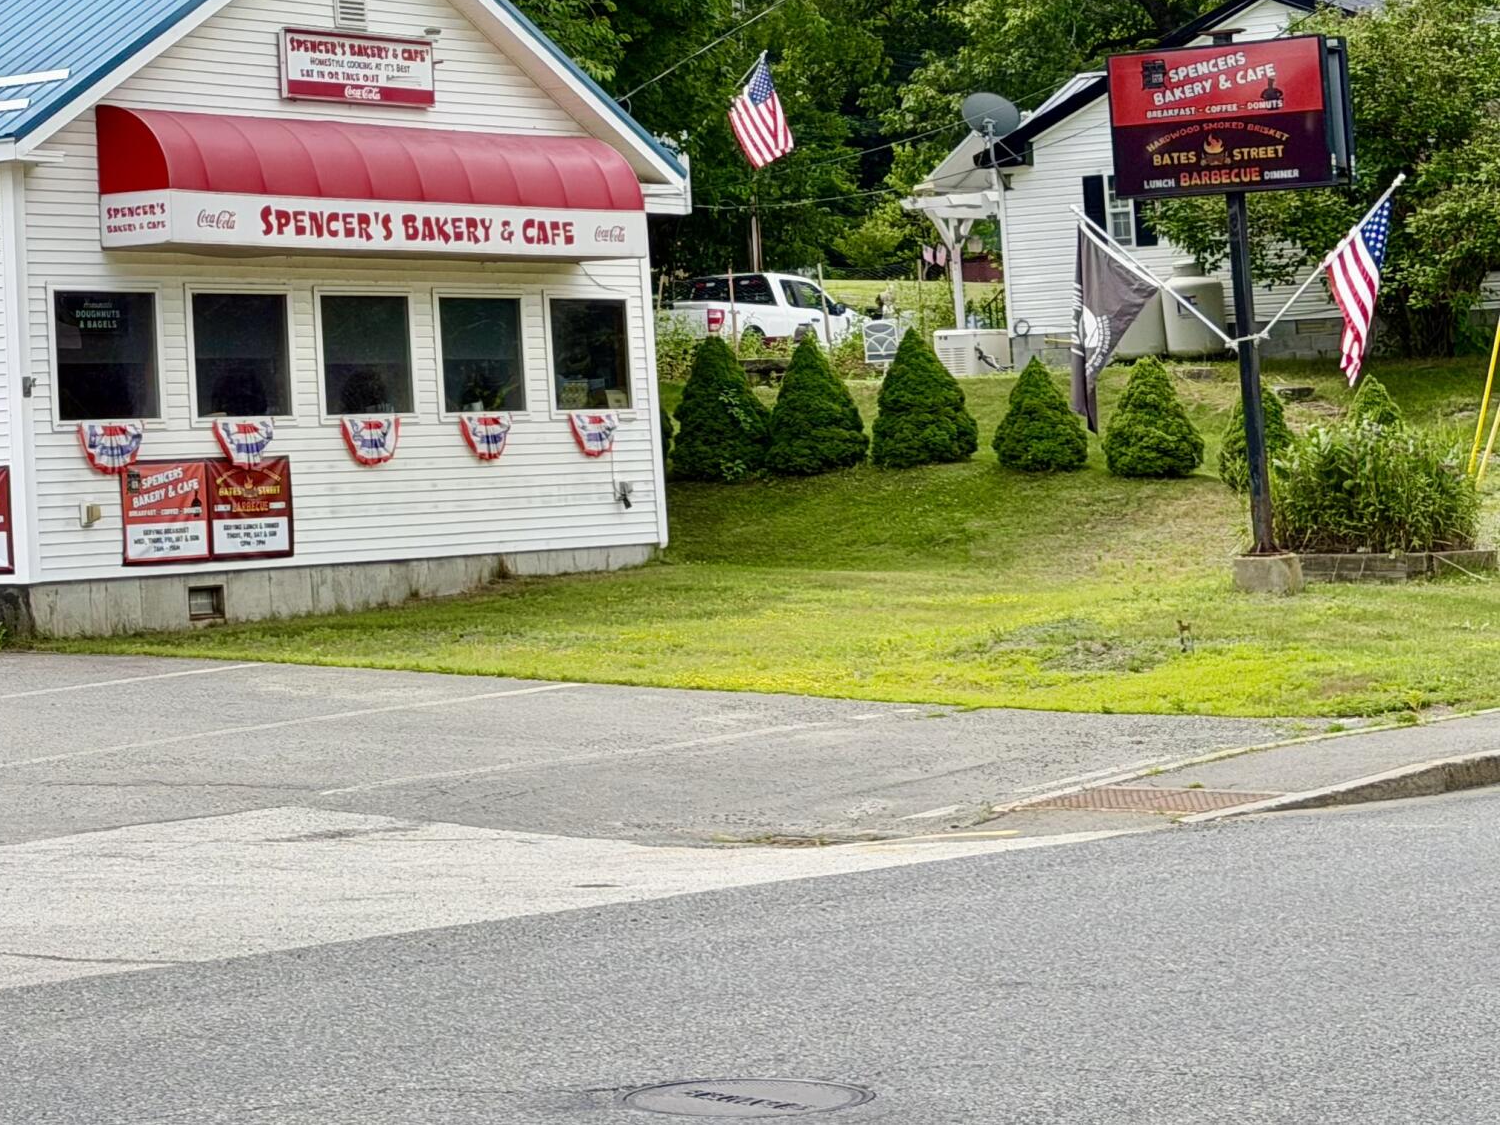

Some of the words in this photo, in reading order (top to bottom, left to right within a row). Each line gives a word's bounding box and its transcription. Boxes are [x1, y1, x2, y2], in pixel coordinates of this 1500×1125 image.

[290, 36, 346, 56] SPENCER'S
[348, 44, 389, 60] BAKERY
[392, 49, 399, 60] &
[310, 57, 345, 68] HOMESTYLE
[346, 61, 373, 71] COOKING
[375, 63, 382, 71] AT
[384, 63, 395, 72] IT'S
[396, 64, 411, 73] BEST
[1168, 52, 1246, 83] SPENCERS
[300, 69, 314, 78] EAT
[317, 70, 325, 79] IN
[328, 71, 339, 80] OR
[342, 73, 360, 82] TAKE
[363, 74, 379, 83] OUT
[1153, 79, 1212, 106] BAKERY
[1218, 74, 1232, 90] &
[1236, 64, 1276, 84] CAFE
[1146, 107, 1196, 119] BREAKFAST
[1205, 104, 1238, 114] COFFEE
[1247, 99, 1283, 109] DONUTS
[1146, 125, 1200, 152] HARDWOOD
[1203, 121, 1244, 131] SMOKED
[1247, 123, 1290, 141] BRISKET
[1153, 151, 1197, 166] BATES
[1233, 145, 1285, 161] STREET
[1144, 178, 1175, 189] LUNCH
[1180, 167, 1261, 187] BARBECUE
[1264, 169, 1299, 180] DINNER
[106, 203, 166, 219] SPENCER'S
[106, 222, 136, 233] BAKERY
[146, 220, 166, 230] CAFE
[260, 205, 393, 241] SPENCER'S
[402, 214, 493, 245] BAKERY
[500, 220, 514, 244] &
[522, 218, 575, 245] CAFE
[76, 310, 120, 318] DOUGHNUTS
[87, 320, 117, 328] BAGELS
[142, 467, 183, 489] SPENCERS
[132, 488, 165, 508] BAKERY
[168, 485, 175, 497] &
[177, 478, 199, 494] CAFE
